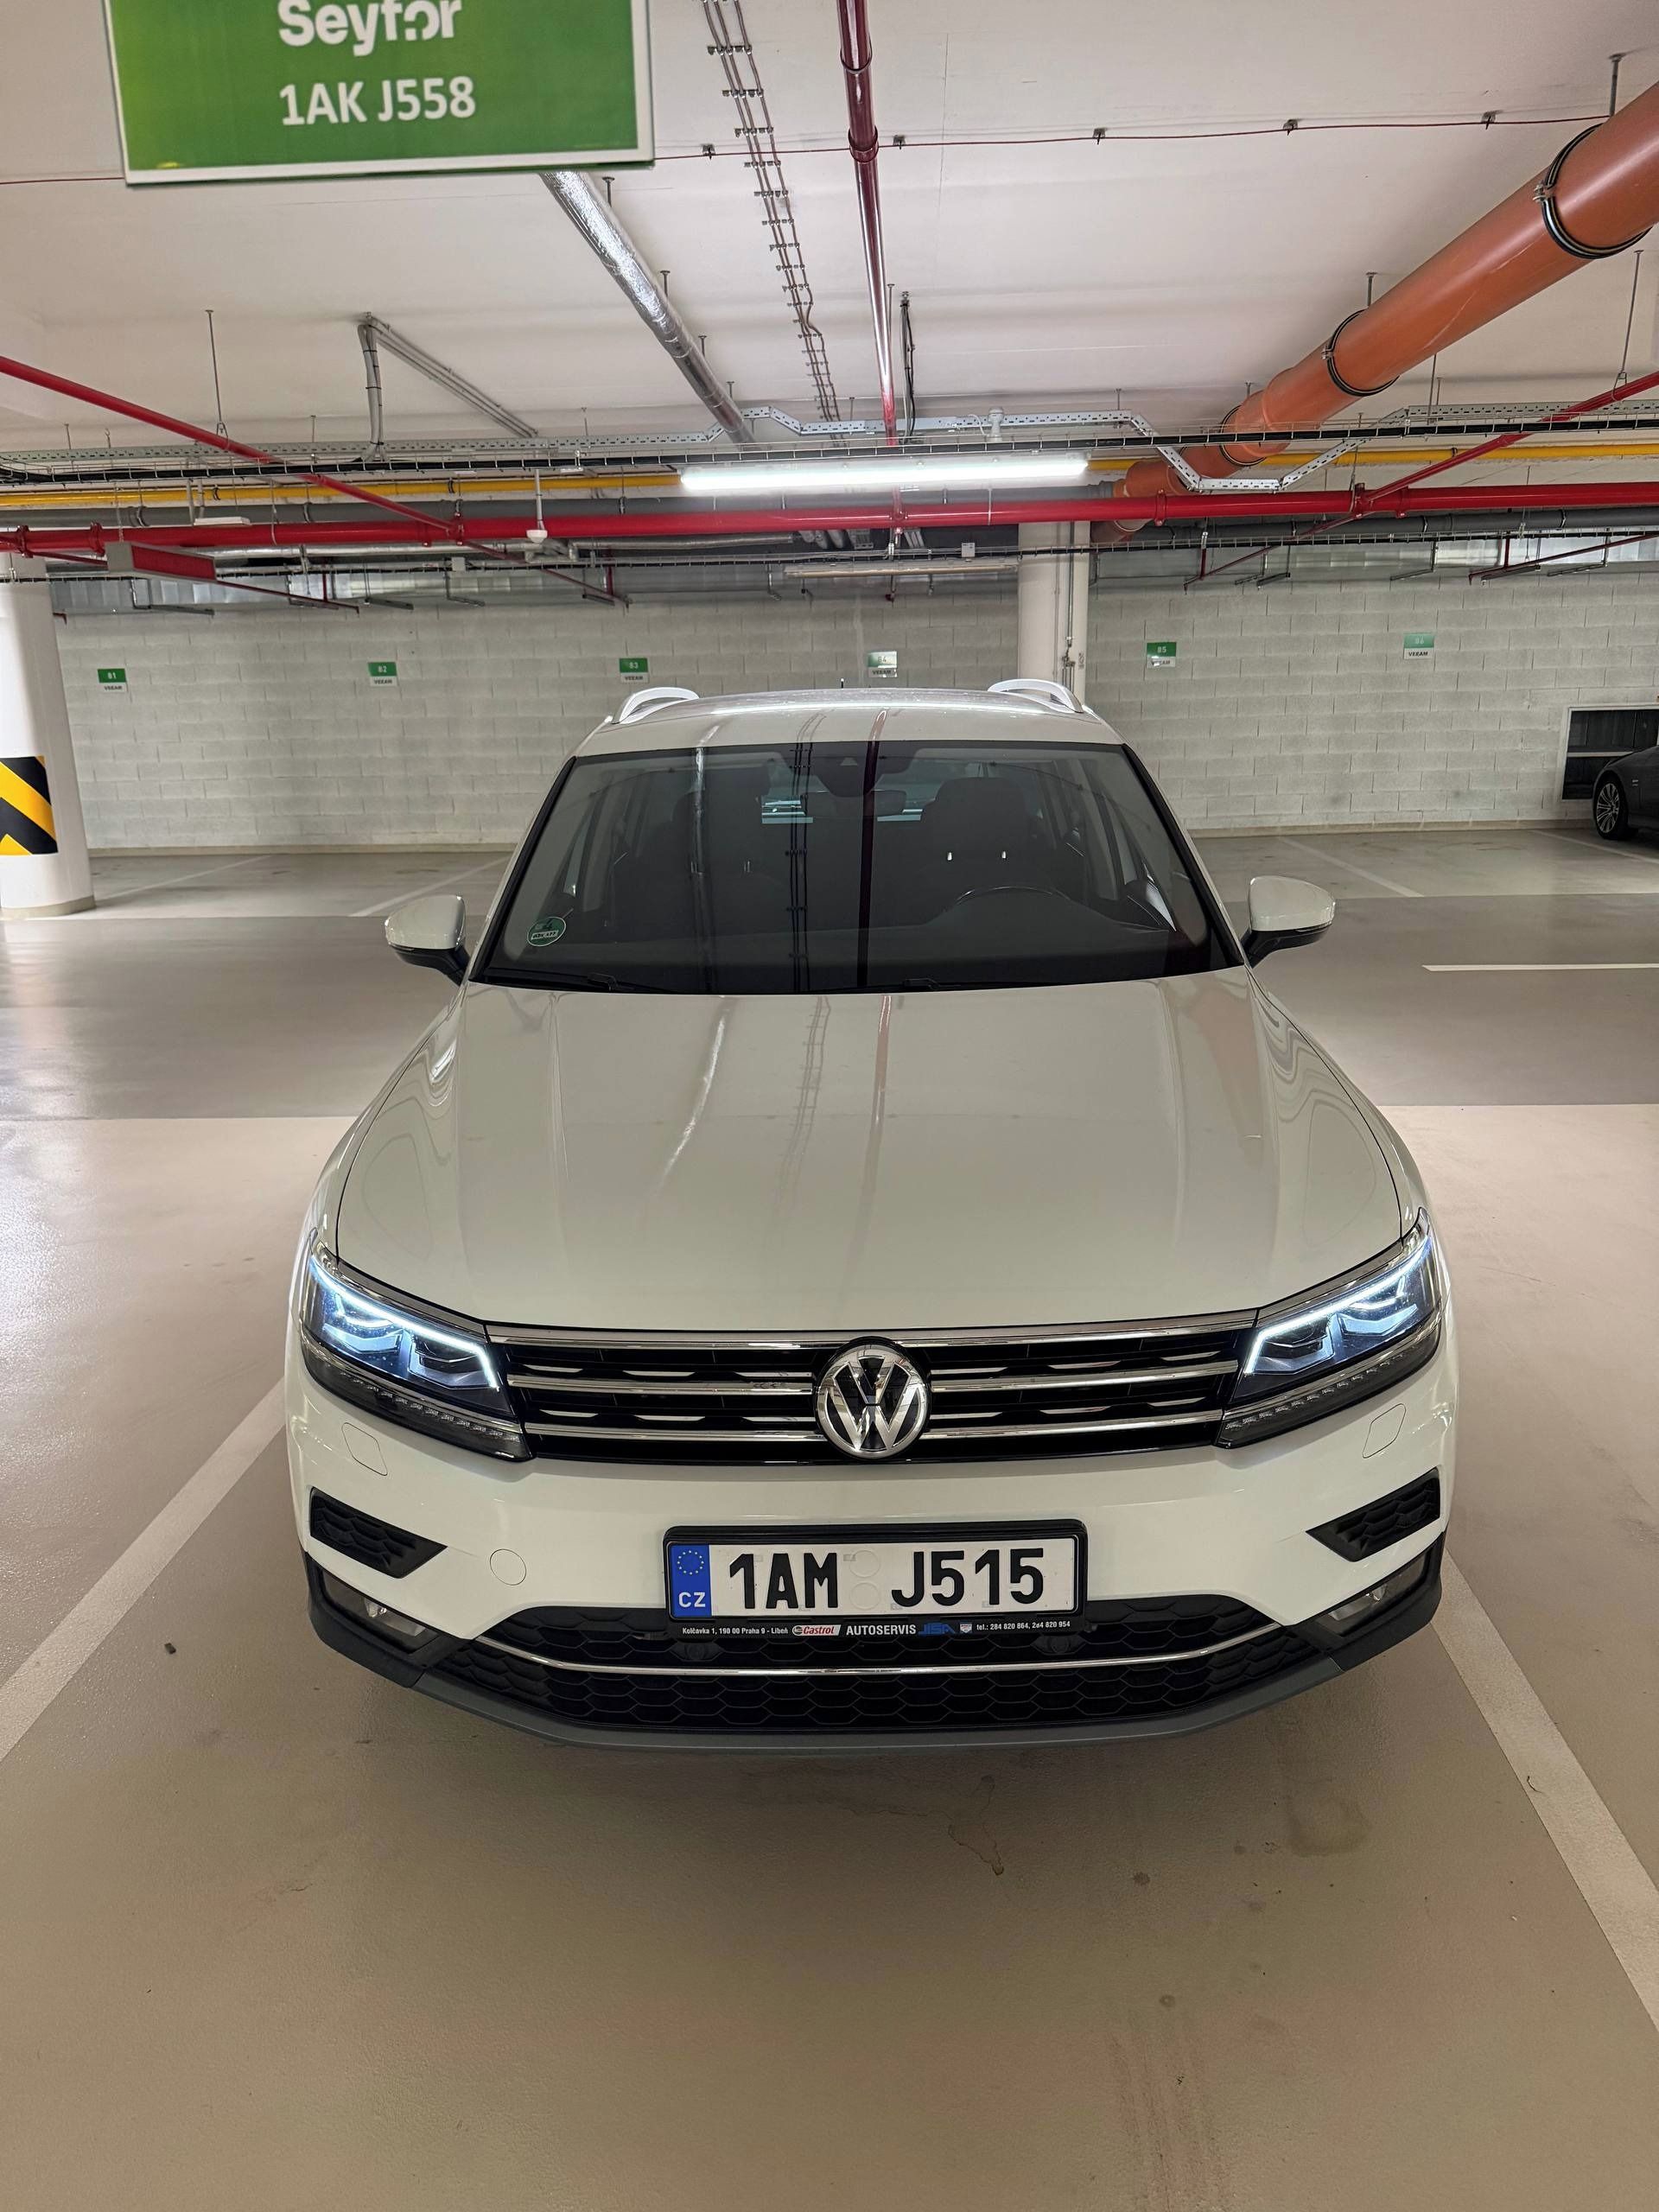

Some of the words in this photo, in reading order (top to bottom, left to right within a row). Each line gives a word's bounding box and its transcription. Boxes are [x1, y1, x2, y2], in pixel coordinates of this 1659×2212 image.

[279, 81, 368, 125] 1AK
[378, 76, 476, 122] J558
[729, 1552, 839, 1610] 1AM
[891, 1548, 1044, 1608] J515
[678, 1592, 706, 1608] CZ
[803, 1626, 835, 1635] Castrol
[846, 1624, 917, 1636] AUTOSERVIS
